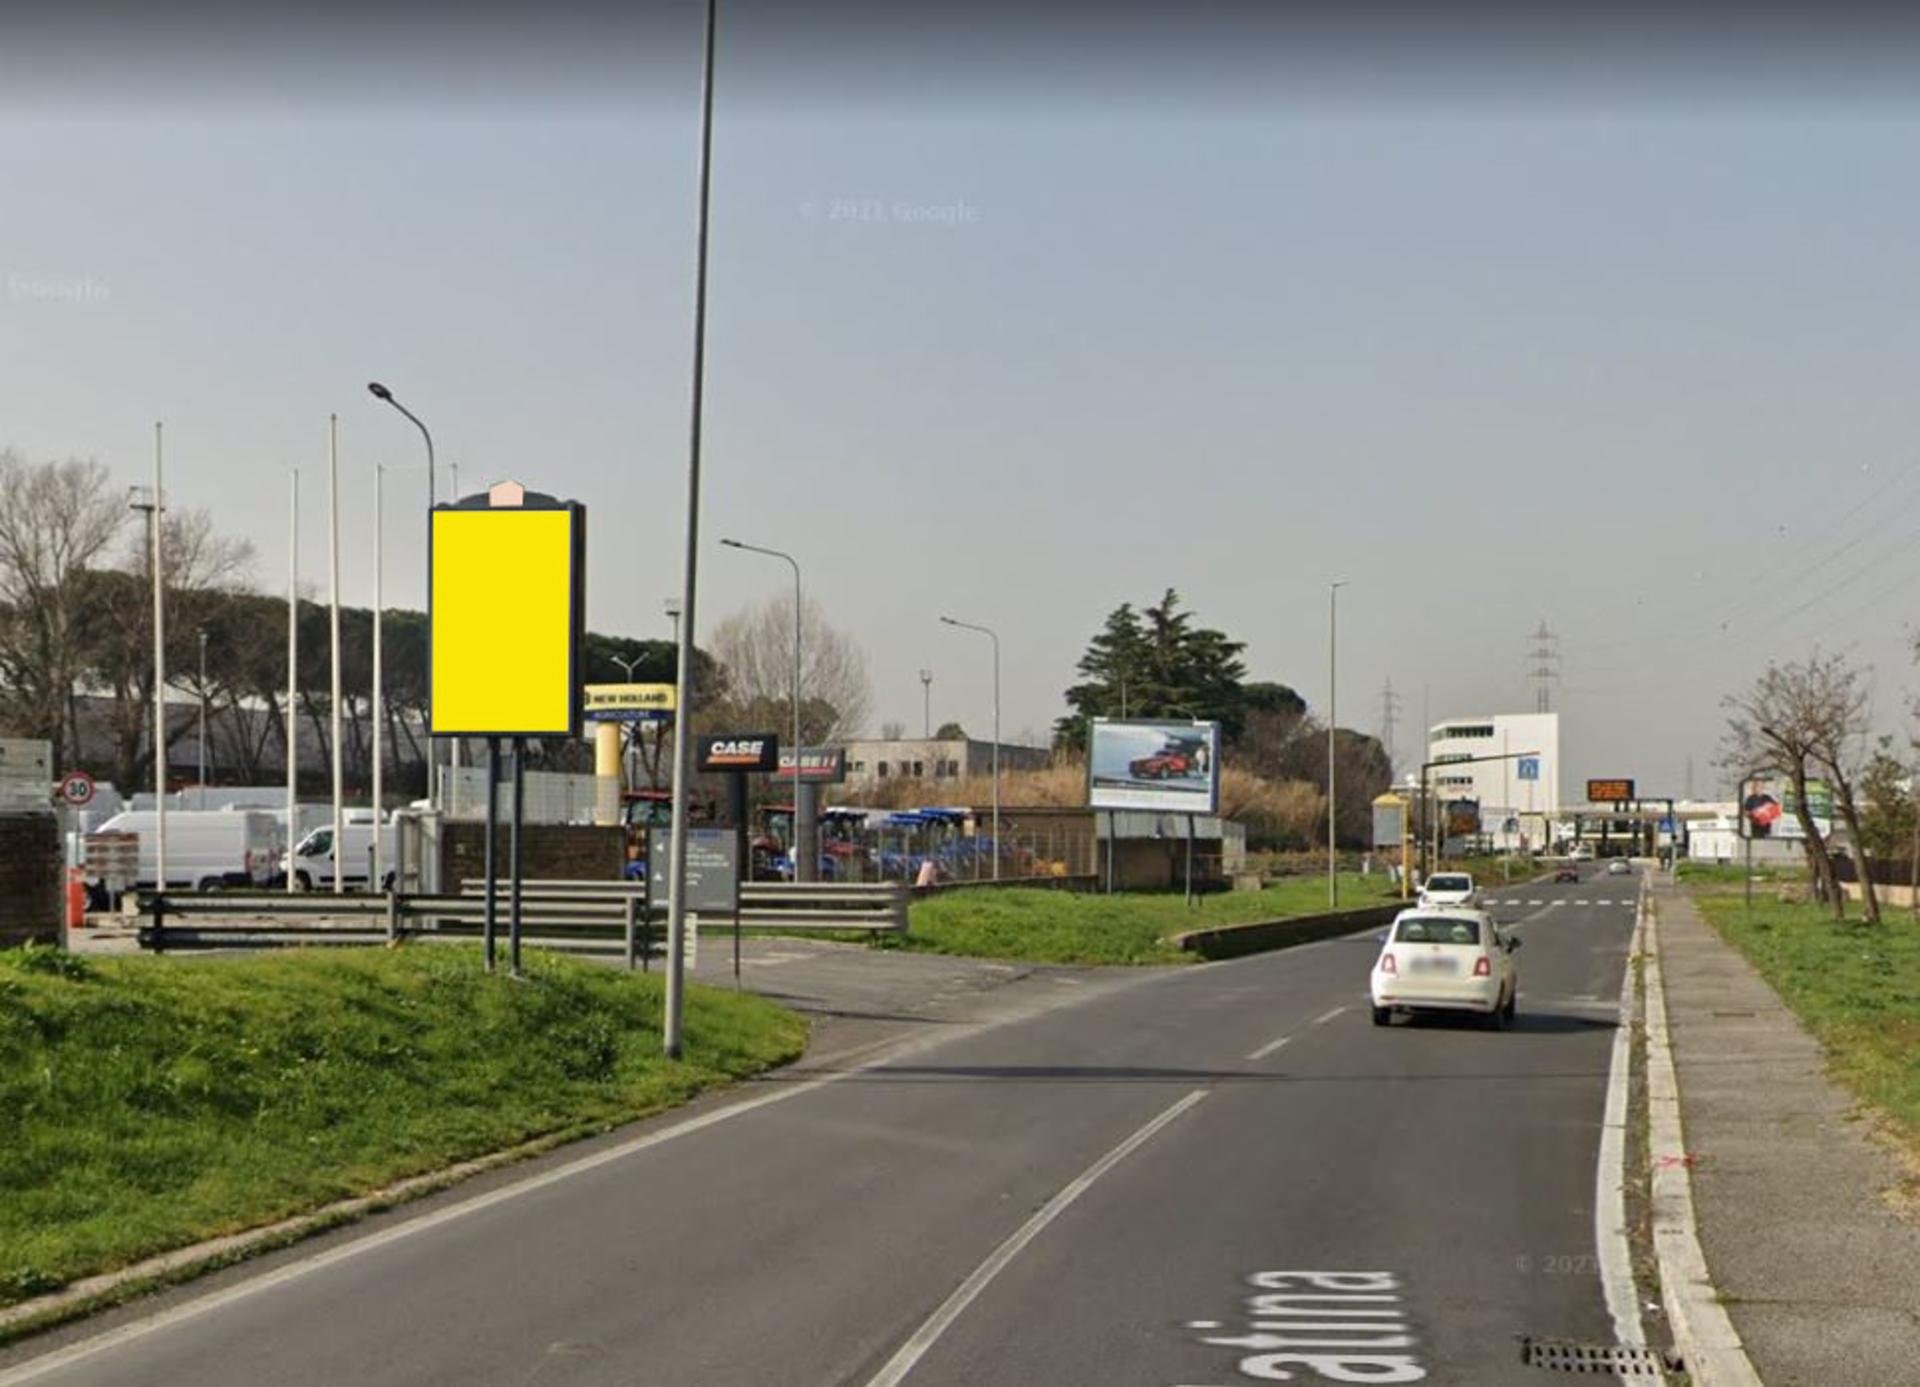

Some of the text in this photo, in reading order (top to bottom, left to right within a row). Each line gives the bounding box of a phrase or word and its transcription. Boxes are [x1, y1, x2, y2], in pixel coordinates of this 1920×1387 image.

[593, 692, 668, 704] NEW HOLLAND
[710, 740, 764, 755] CASE
[778, 755, 822, 768] CASE
[69, 781, 88, 797] 30
